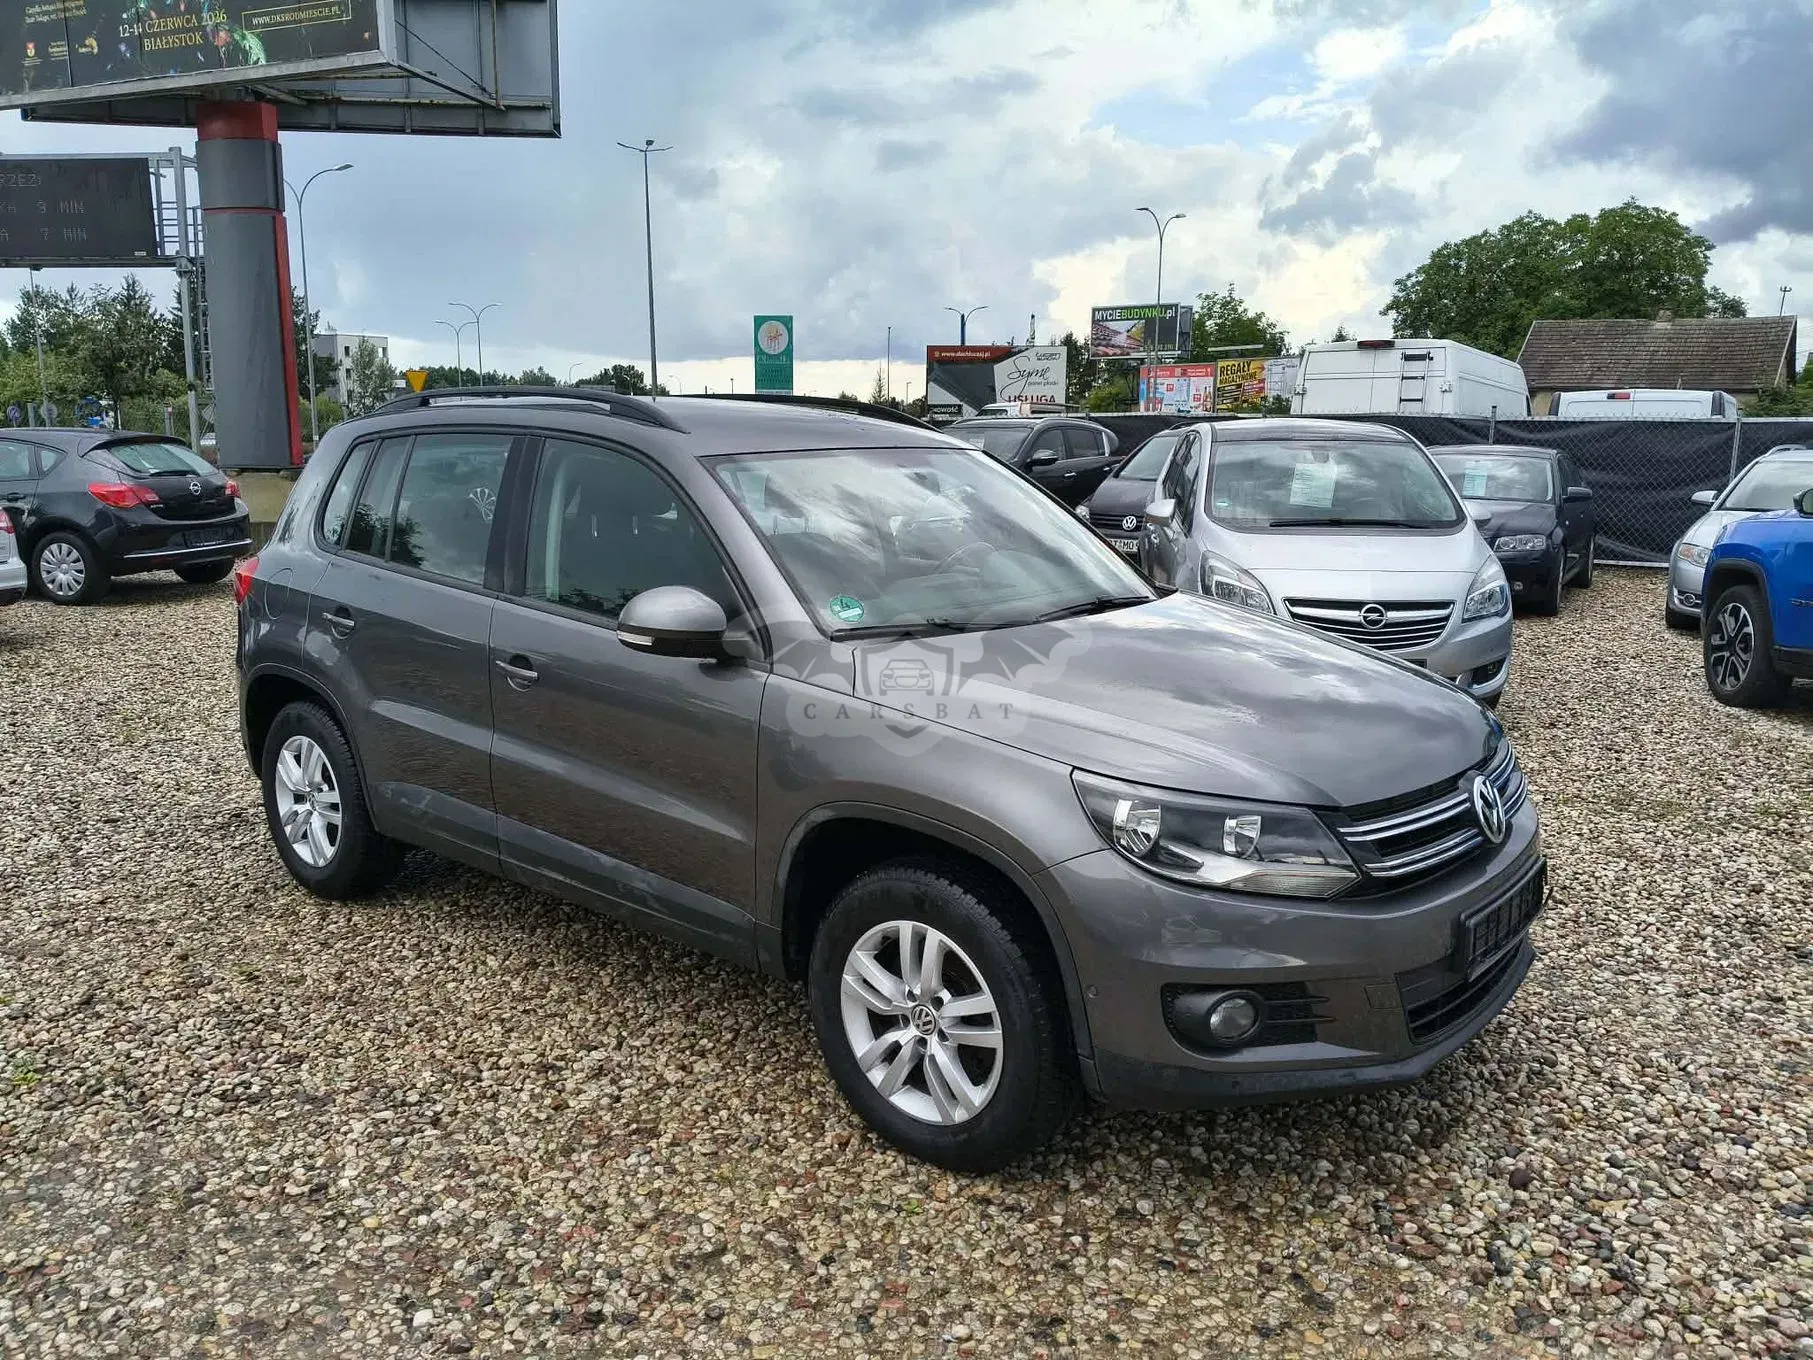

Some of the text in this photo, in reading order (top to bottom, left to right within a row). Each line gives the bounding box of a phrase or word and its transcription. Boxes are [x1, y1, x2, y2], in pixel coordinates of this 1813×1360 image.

[145, 14, 198, 33] CZERWCA
[201, 9, 227, 25] 2026
[144, 32, 203, 51] BIAŁYSTOK
[1095, 306, 1176, 320] MYCIEBUDYNKU.pl
[1219, 360, 1252, 377] REGAŁY
